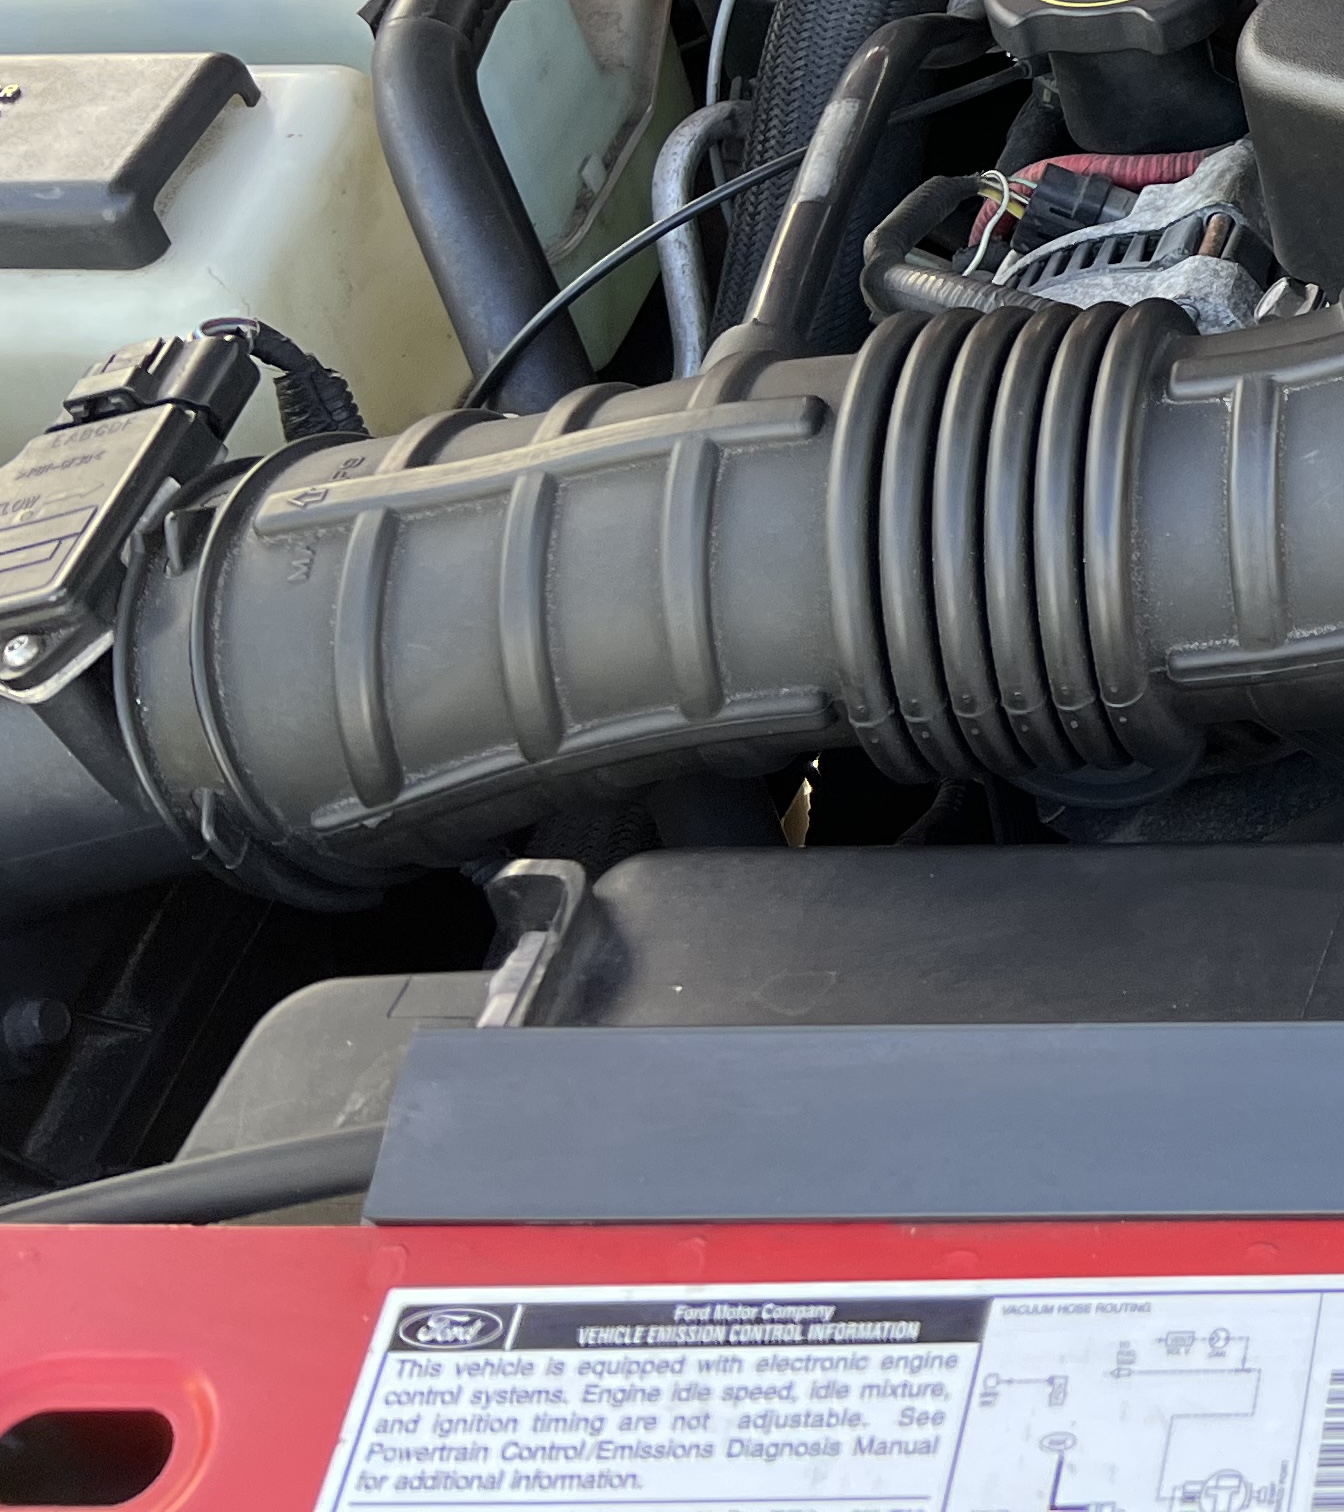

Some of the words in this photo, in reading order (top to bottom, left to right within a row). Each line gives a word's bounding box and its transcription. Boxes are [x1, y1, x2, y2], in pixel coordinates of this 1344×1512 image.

[674, 1304, 711, 1321] Ford
[713, 1304, 758, 1321] Motor
[761, 1303, 836, 1323] Company
[1002, 1304, 1054, 1315] VACUUM
[1057, 1303, 1091, 1314] HOSE
[1095, 1302, 1151, 1313] ROUTING
[416, 1314, 485, 1342] Ford
[577, 1325, 643, 1346] VEHICLE
[646, 1325, 725, 1345] EMISSION
[729, 1323, 803, 1343] CONTROL
[808, 1321, 921, 1341] INFORMATION
[397, 1358, 441, 1377] This
[456, 1357, 534, 1376] vehicle
[546, 1356, 565, 1376] is
[578, 1354, 685, 1382] equipped
[697, 1354, 743, 1373] with
[755, 1353, 870, 1372] electronic
[880, 1352, 958, 1374] engine
[384, 1384, 461, 1405] control
[470, 1386, 569, 1409] systems.
[582, 1384, 660, 1407] Engine
[672, 1382, 711, 1402] idle
[810, 1381, 849, 1400] idle
[375, 1414, 420, 1434] and
[432, 1413, 517, 1438] ignition
[532, 1412, 605, 1436] timing
[619, 1415, 656, 1432] are
[672, 1412, 710, 1430] not
[737, 1408, 870, 1434] adjustable.
[898, 1407, 945, 1427] See
[365, 1442, 488, 1463] Powertrain
[501, 1438, 713, 1462] Control/Emissions
[726, 1438, 841, 1461] Diagnosis
[853, 1436, 940, 1456] Manual
[357, 1469, 388, 1491] for
[395, 1469, 503, 1490] additional
[511, 1468, 643, 1489] information.
